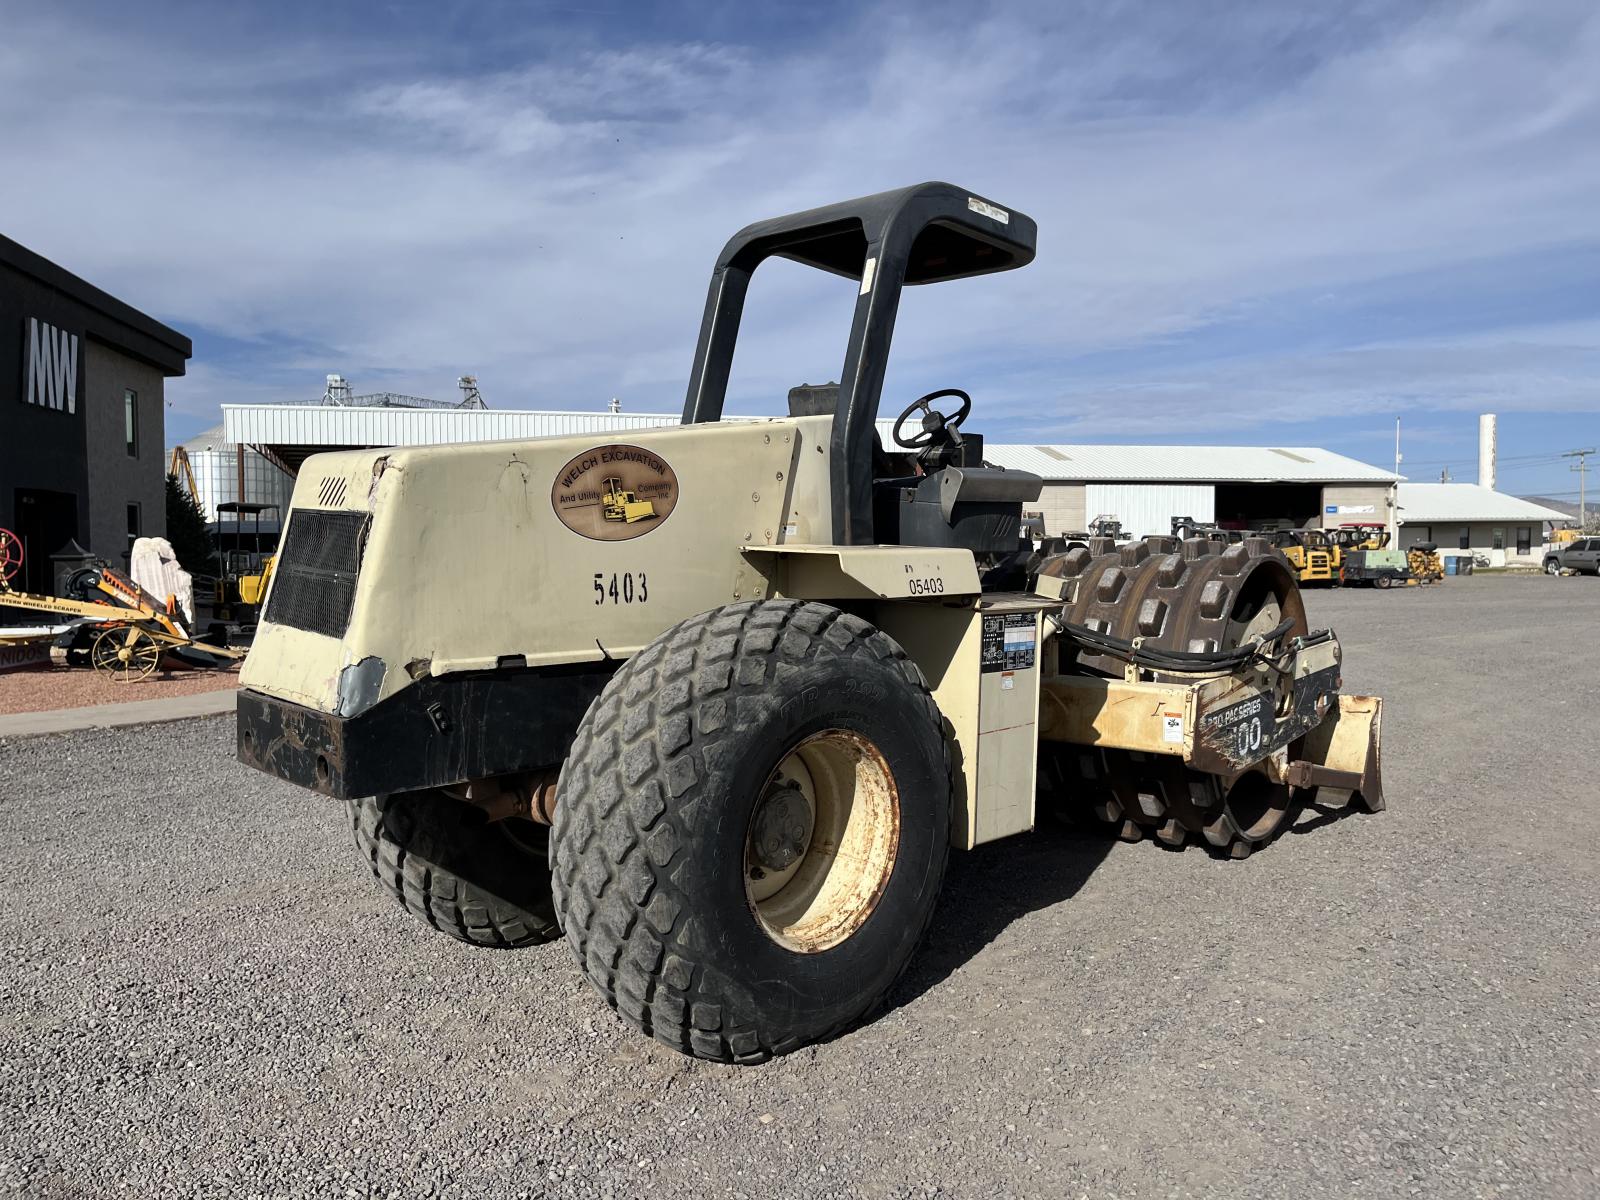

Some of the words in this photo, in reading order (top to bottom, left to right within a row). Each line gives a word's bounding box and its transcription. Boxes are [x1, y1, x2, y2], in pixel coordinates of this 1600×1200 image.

[28, 317, 78, 414] MW
[562, 457, 598, 488] WELCH
[601, 451, 665, 475] EXCAVATION
[560, 494, 576, 503] And
[578, 491, 601, 501] Utility
[594, 573, 648, 605] 5403
[909, 577, 944, 595] 05403
[23, 601, 52, 610] WHEELED
[53, 604, 82, 613] SCRAPER
